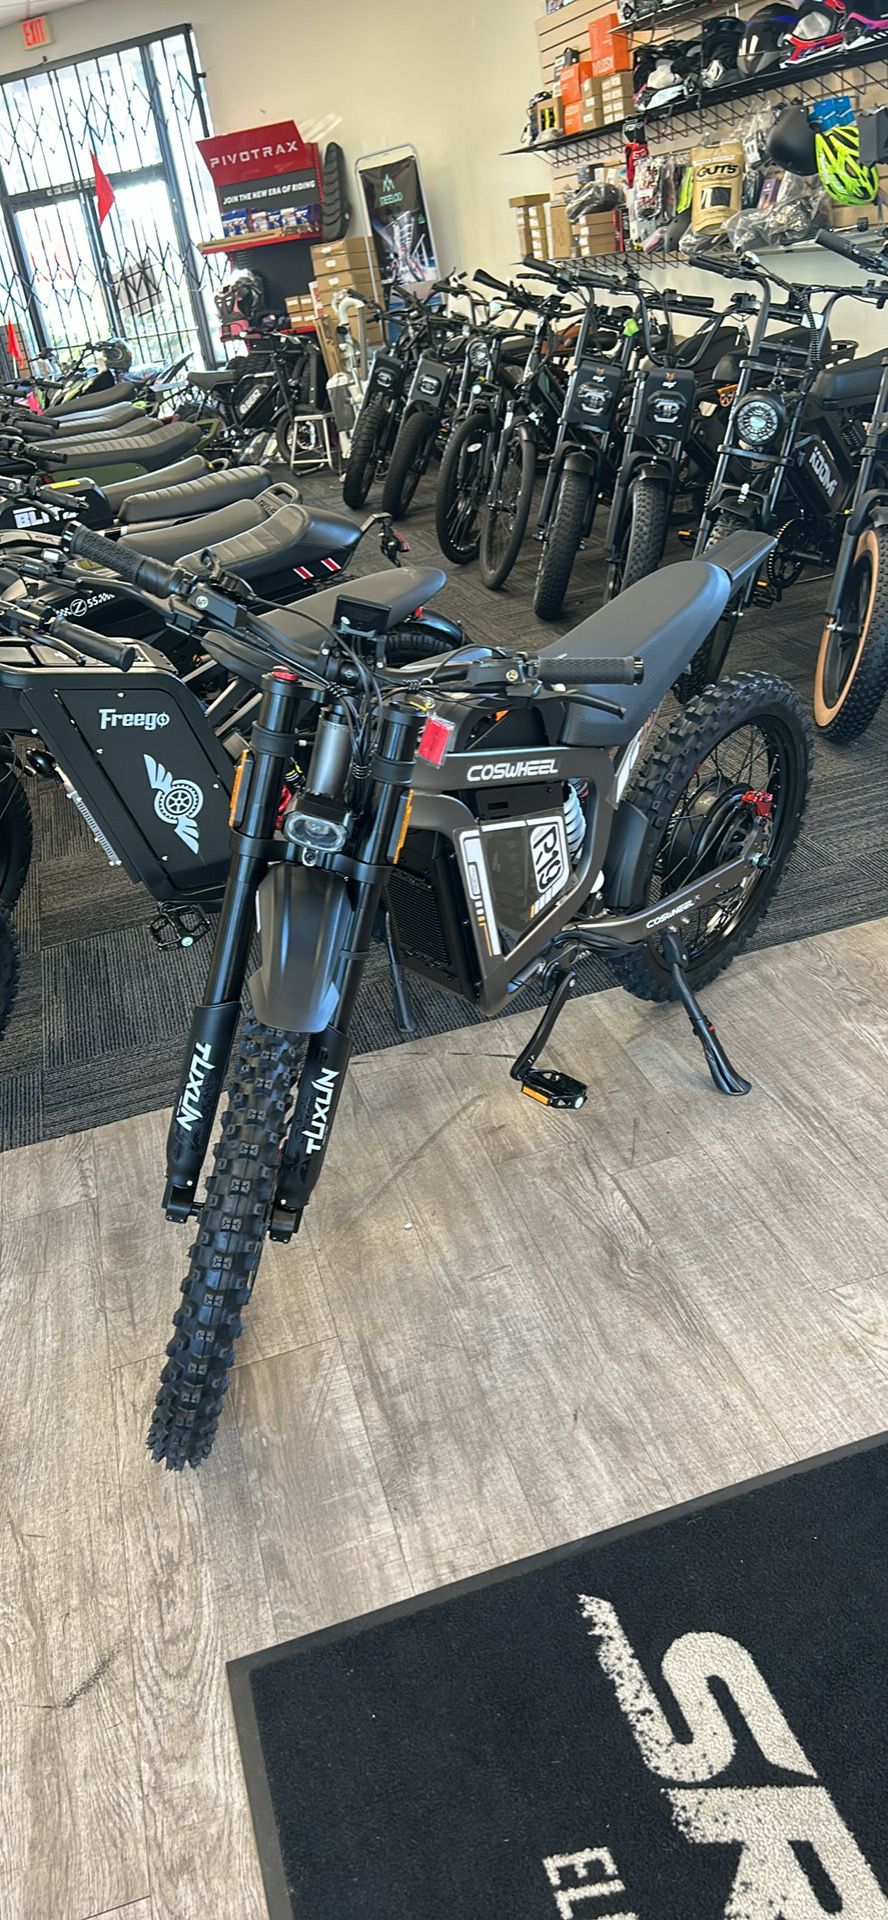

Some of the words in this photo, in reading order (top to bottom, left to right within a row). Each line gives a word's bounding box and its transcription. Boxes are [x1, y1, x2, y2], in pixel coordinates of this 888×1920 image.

[22, 18, 46, 47] EXIT
[209, 140, 299, 169] PIVOTRAX
[696, 164, 739, 178] GUTS
[223, 195, 239, 205] JOIN
[239, 192, 252, 202] THE
[252, 189, 268, 199] NEW
[268, 186, 281, 196] ERA
[281, 184, 291, 193] OF
[291, 179, 316, 191] RIDING
[98, 706, 170, 730] Freego
[466, 759, 558, 782] COSWHEEL
[176, 1042, 216, 1132] TUXUN
[301, 1067, 340, 1155] TUXUN
[543, 1846, 640, 1920] EL
